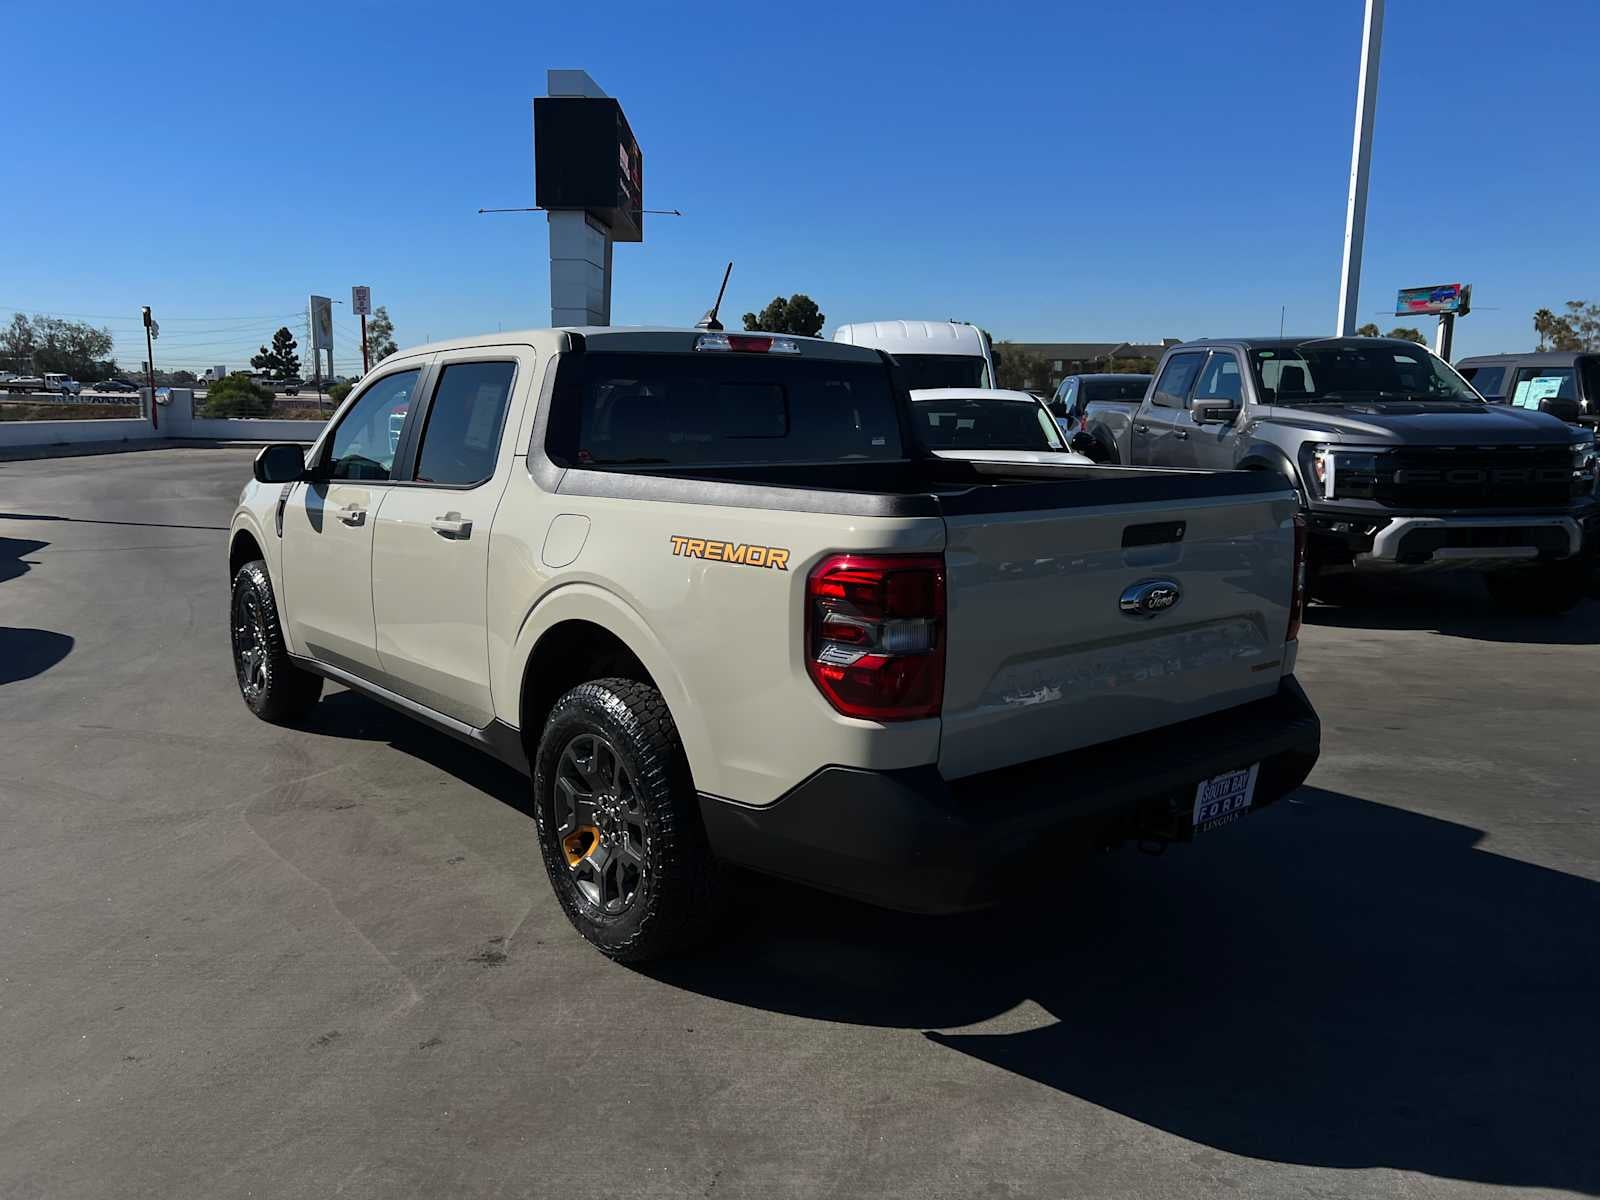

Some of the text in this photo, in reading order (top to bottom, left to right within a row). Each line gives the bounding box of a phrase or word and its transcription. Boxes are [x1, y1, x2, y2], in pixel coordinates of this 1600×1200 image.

[670, 535, 788, 571] TREMOR
[1148, 589, 1177, 609] Ford
[1202, 774, 1249, 802] SOUTH BAY
[1200, 795, 1243, 818] FORD
